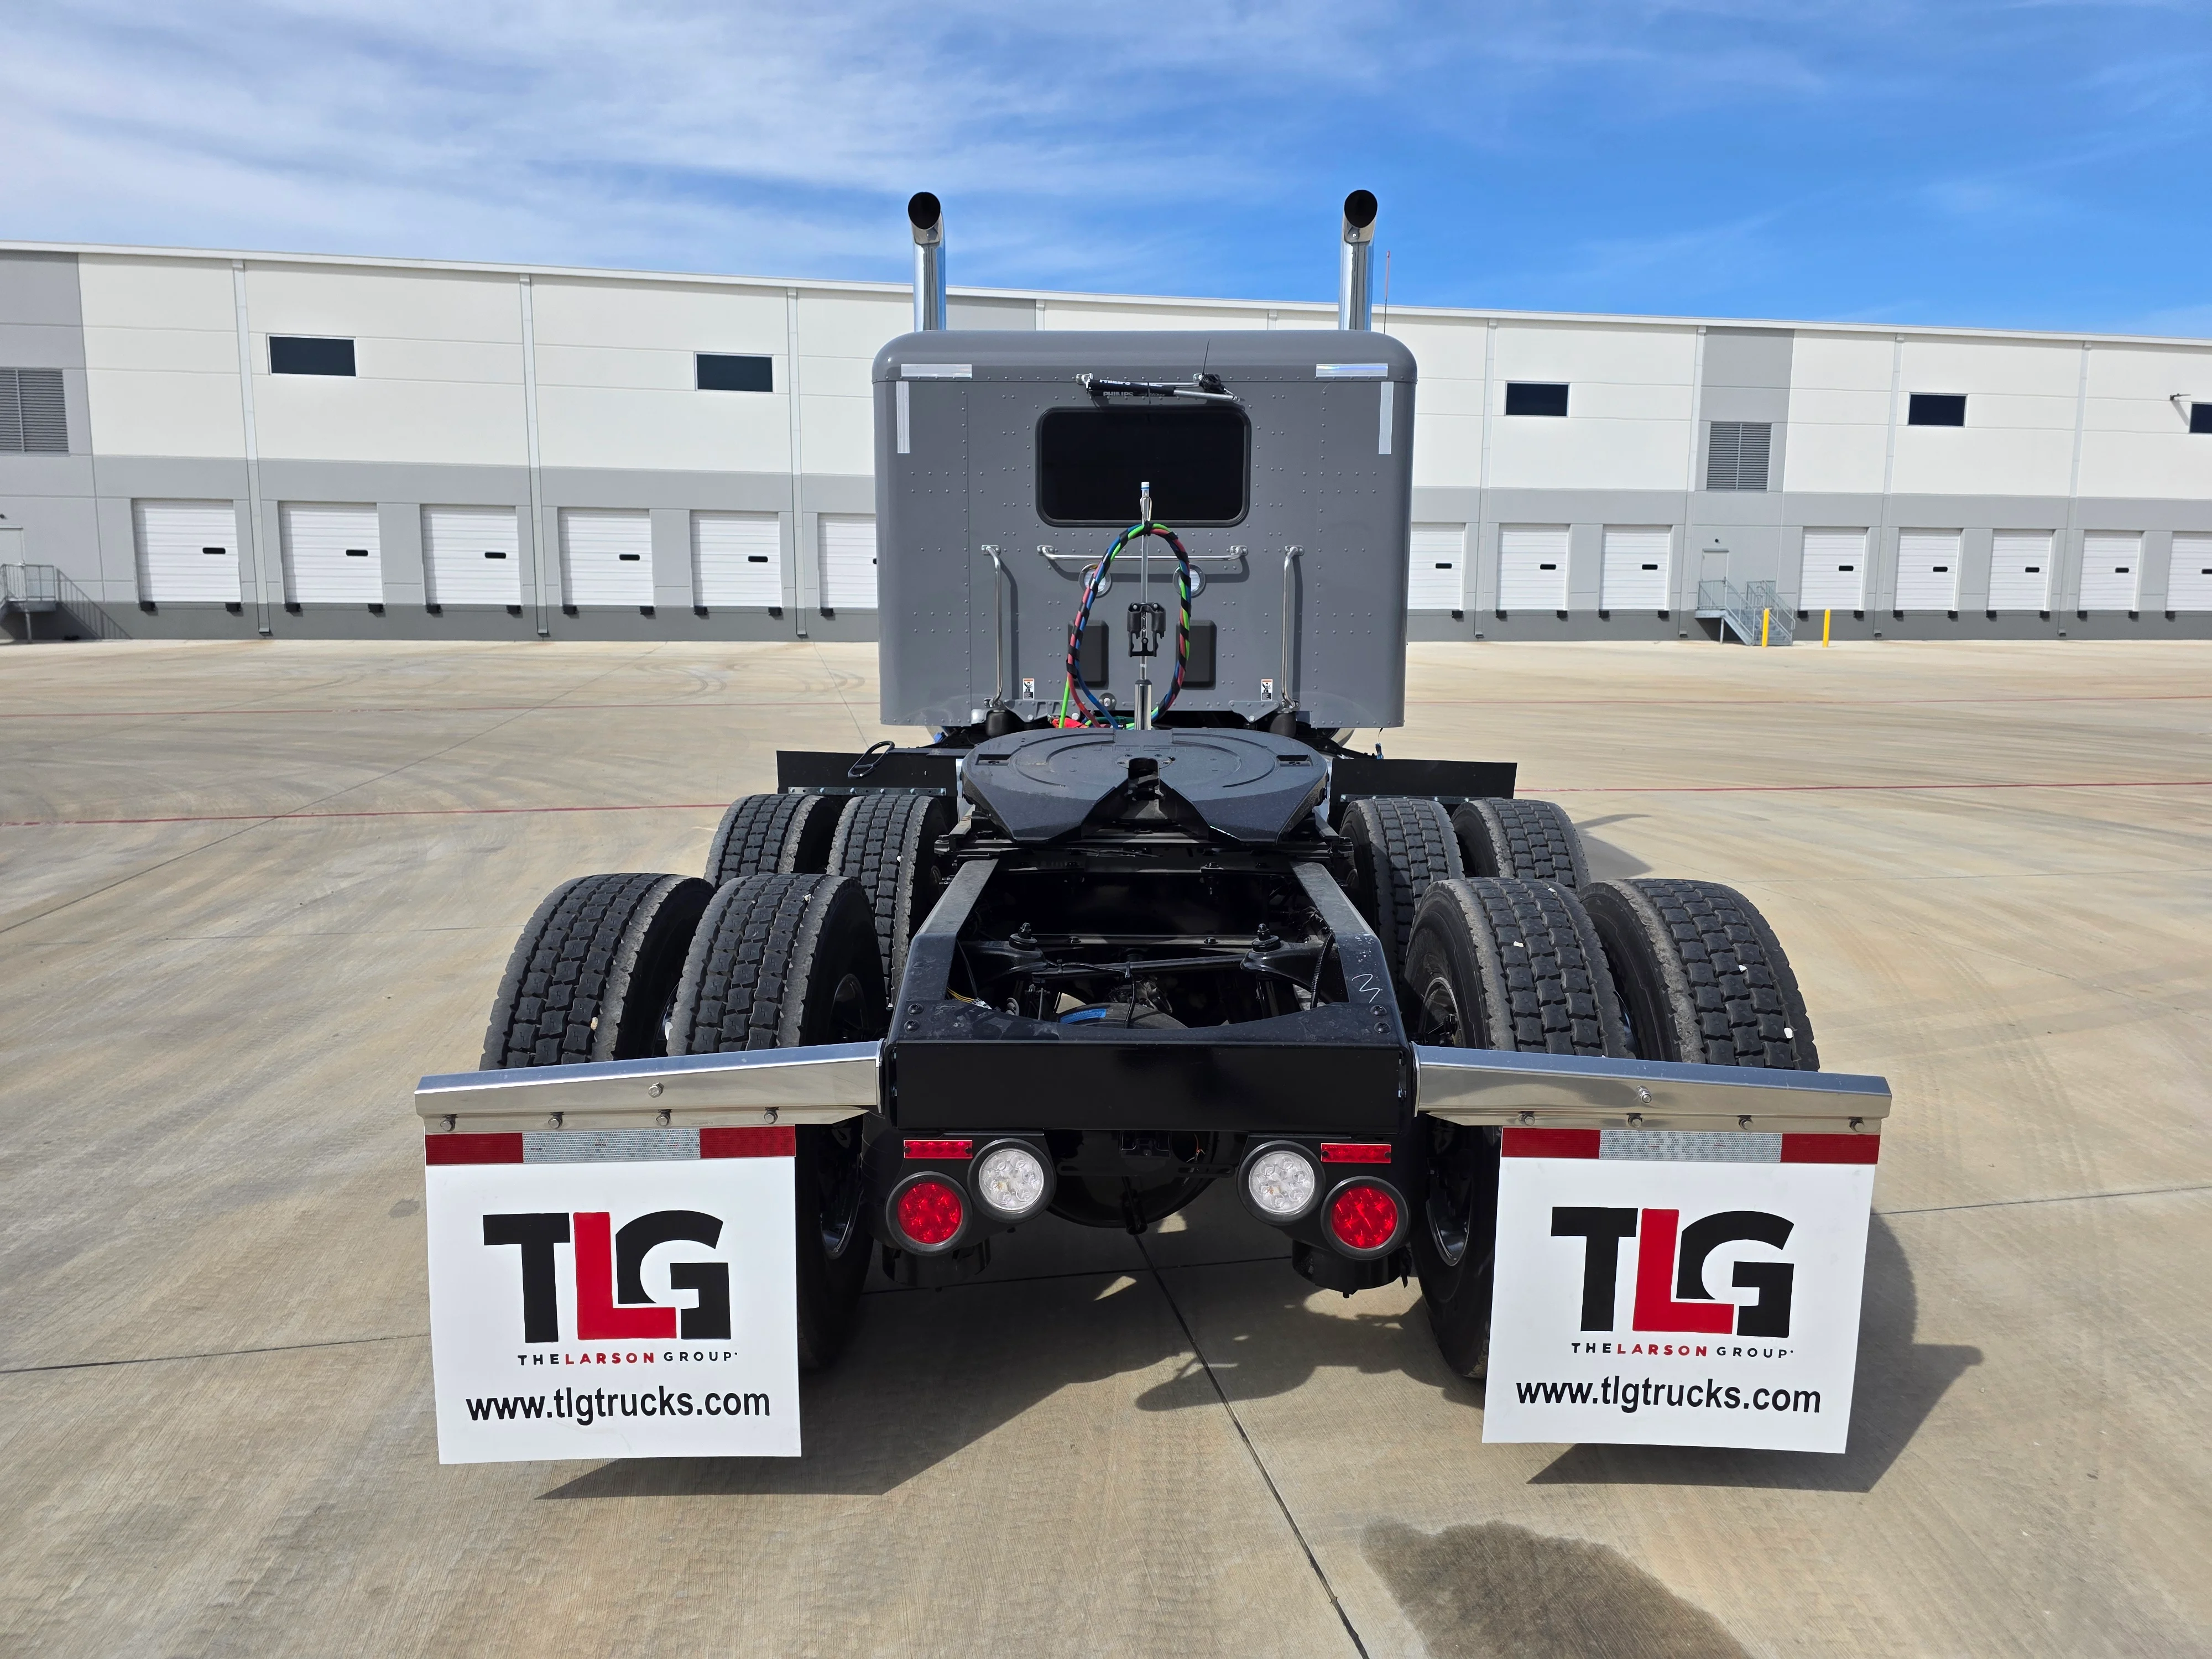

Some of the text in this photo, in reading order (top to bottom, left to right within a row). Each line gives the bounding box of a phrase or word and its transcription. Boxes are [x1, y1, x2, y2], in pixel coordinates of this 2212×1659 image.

[483, 1210, 731, 1343] TLG
[1551, 1206, 1794, 1338] TLG
[518, 1353, 560, 1366] THE
[565, 1352, 654, 1365] LARSON
[1571, 1343, 1611, 1354] THE
[1617, 1343, 1707, 1357] LARSON
[466, 1386, 770, 1426] www.tlgtrucks.com
[1516, 1376, 1820, 1413] www.tlgtrucks.com
